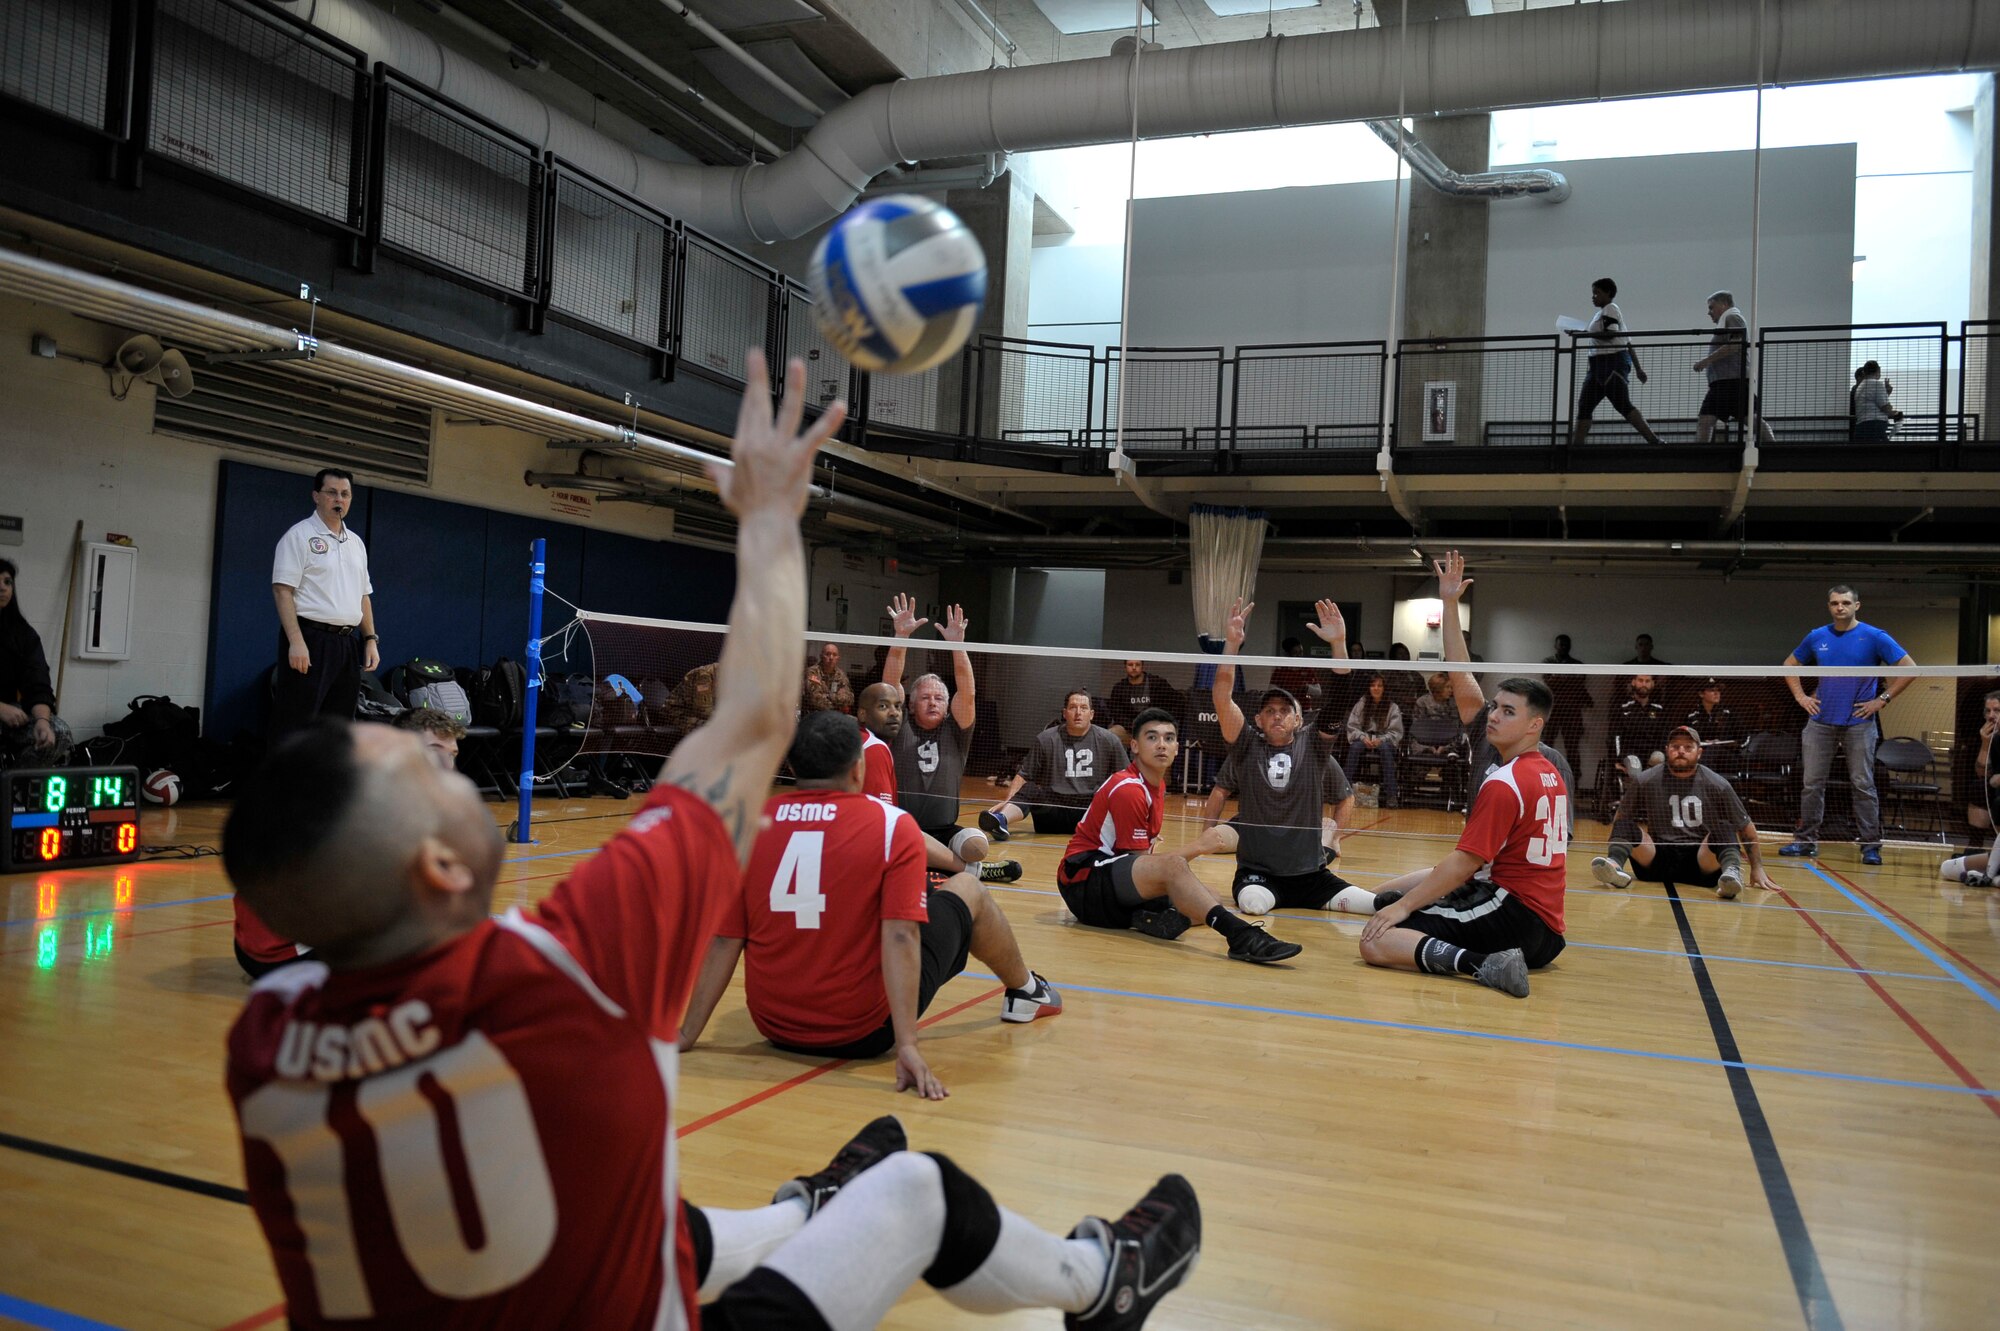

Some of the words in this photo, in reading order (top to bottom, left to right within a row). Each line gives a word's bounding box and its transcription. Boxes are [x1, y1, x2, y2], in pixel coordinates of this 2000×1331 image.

[556, 492, 569, 501] HOUR
[570, 494, 592, 506] FIREWALL
[917, 740, 940, 773] 9
[1065, 748, 1094, 778] 12
[1267, 753, 1292, 788] 8
[47, 776, 67, 813] 8
[94, 776, 122, 807] 14
[774, 802, 838, 822] USMC
[1668, 794, 1704, 828] 10
[41, 827, 60, 860] 0
[117, 823, 136, 854] 0
[1525, 795, 1567, 867] 34
[769, 830, 826, 929] 4
[274, 999, 442, 1083] USMC
[239, 1027, 560, 1321] 10
